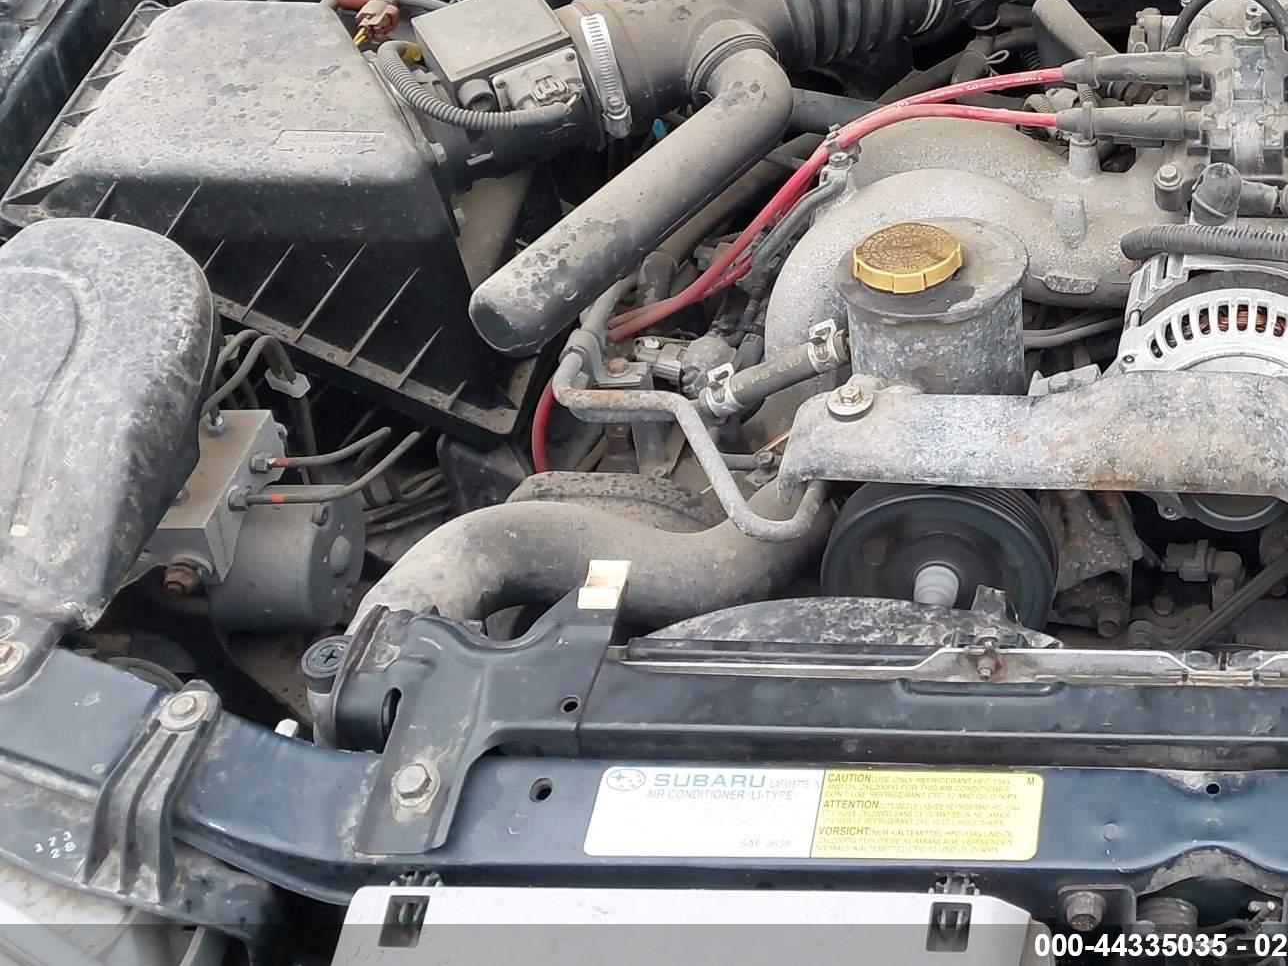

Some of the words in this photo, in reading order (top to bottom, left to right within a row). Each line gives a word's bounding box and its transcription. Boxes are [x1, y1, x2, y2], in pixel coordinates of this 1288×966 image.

[653, 774, 766, 788] SUBARU
[893, 777, 912, 785] ONLY
[1026, 776, 1035, 785] M
[646, 790, 664, 799] AIR
[668, 790, 744, 800] CONDITIONER
[739, 839, 760, 849] SAE
